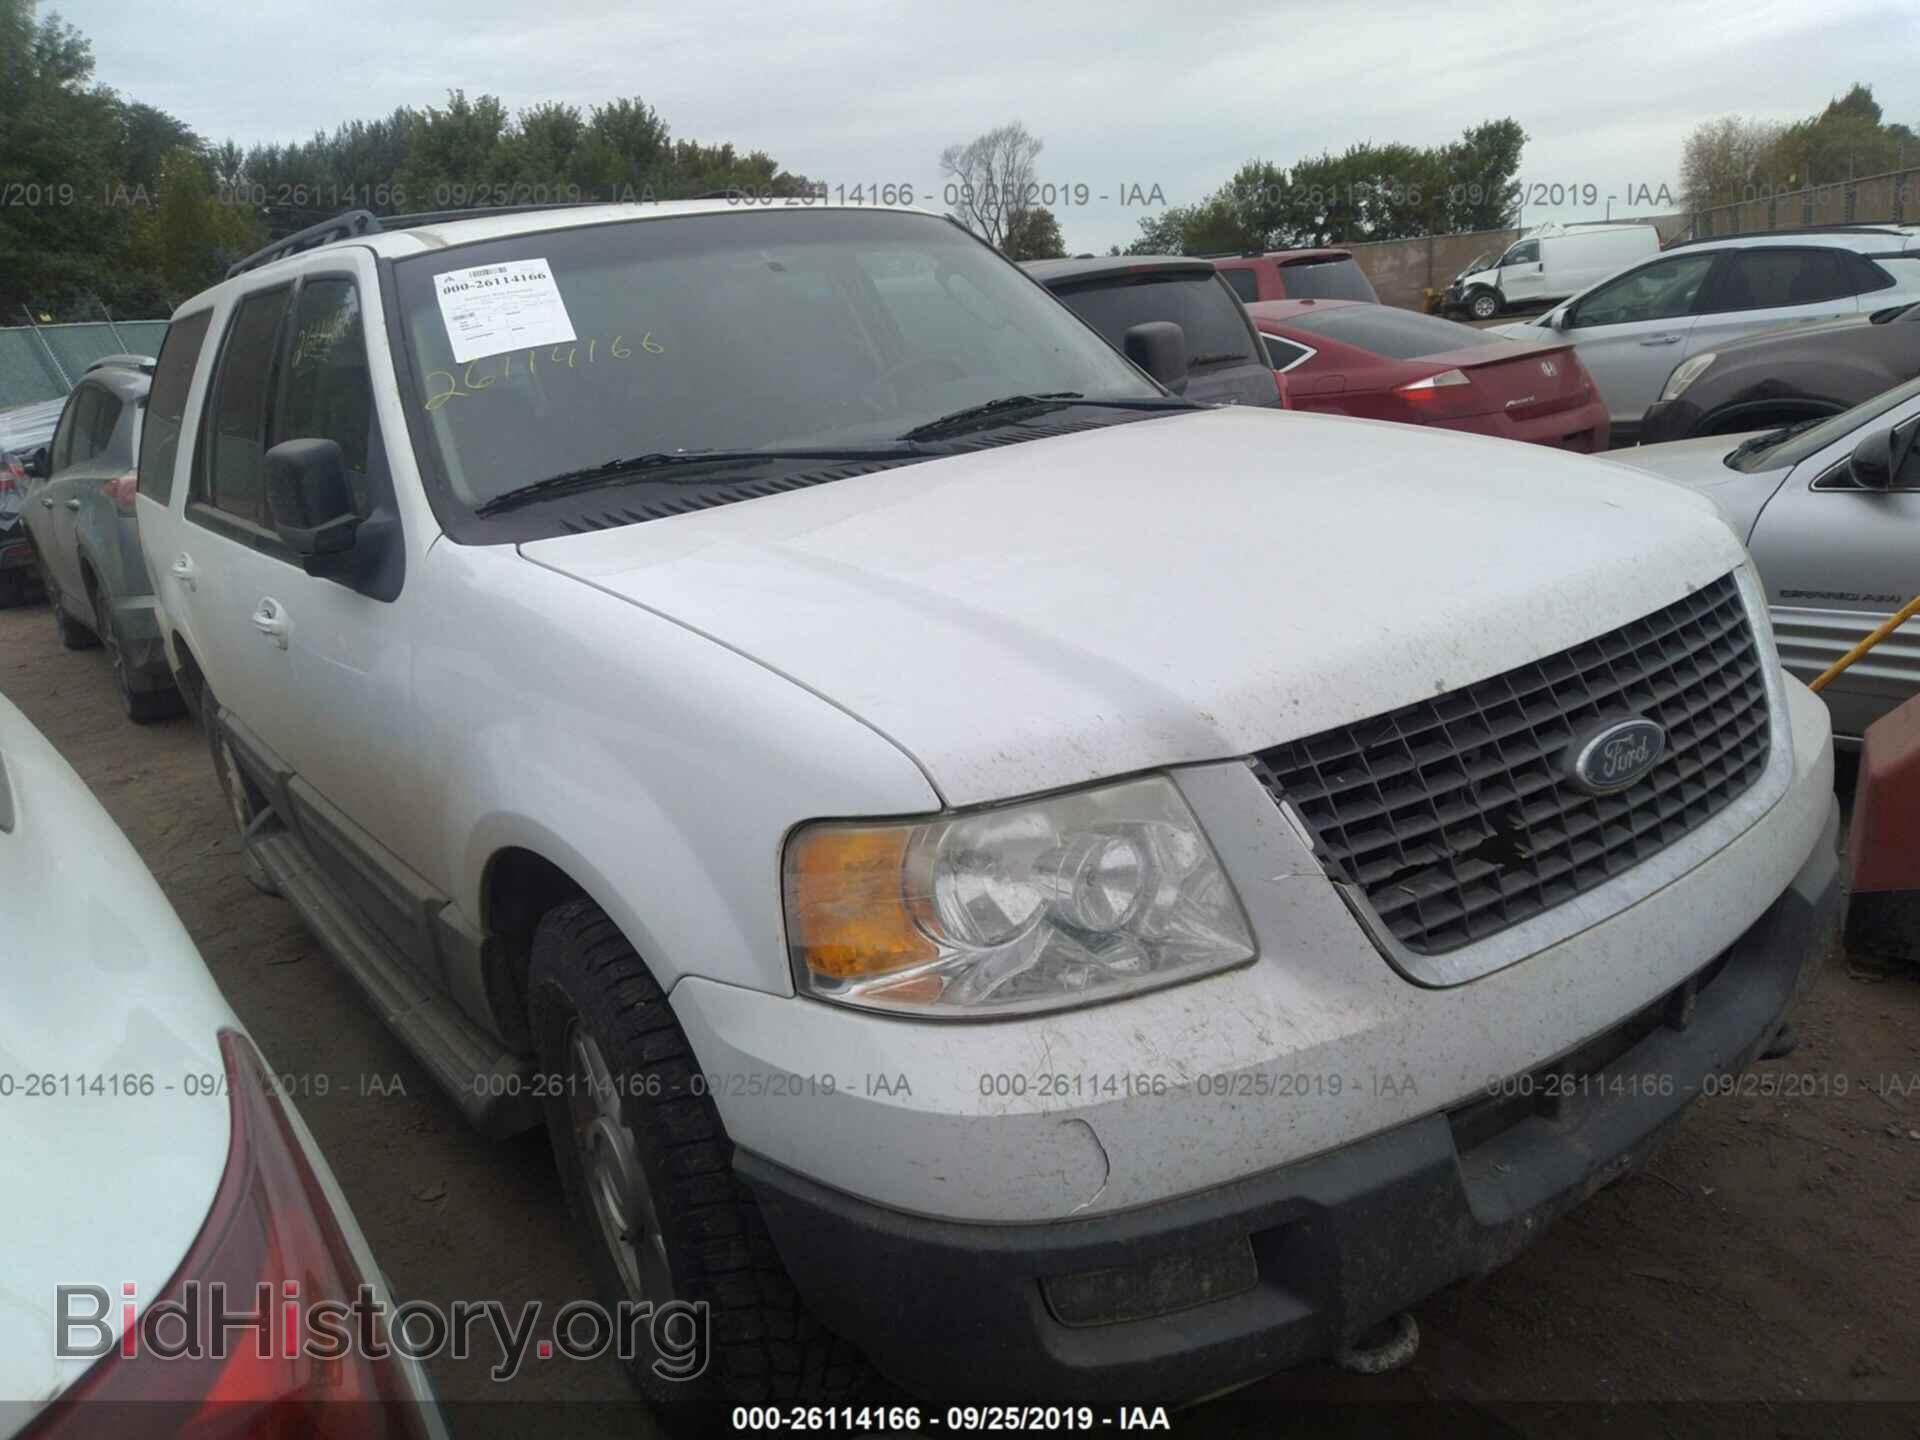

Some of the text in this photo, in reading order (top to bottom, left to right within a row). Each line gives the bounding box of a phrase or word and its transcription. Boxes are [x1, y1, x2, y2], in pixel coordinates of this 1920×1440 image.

[442, 271, 547, 296] 000-26114166
[424, 331, 665, 412] 26114166
[1602, 733, 1649, 778] Ford
